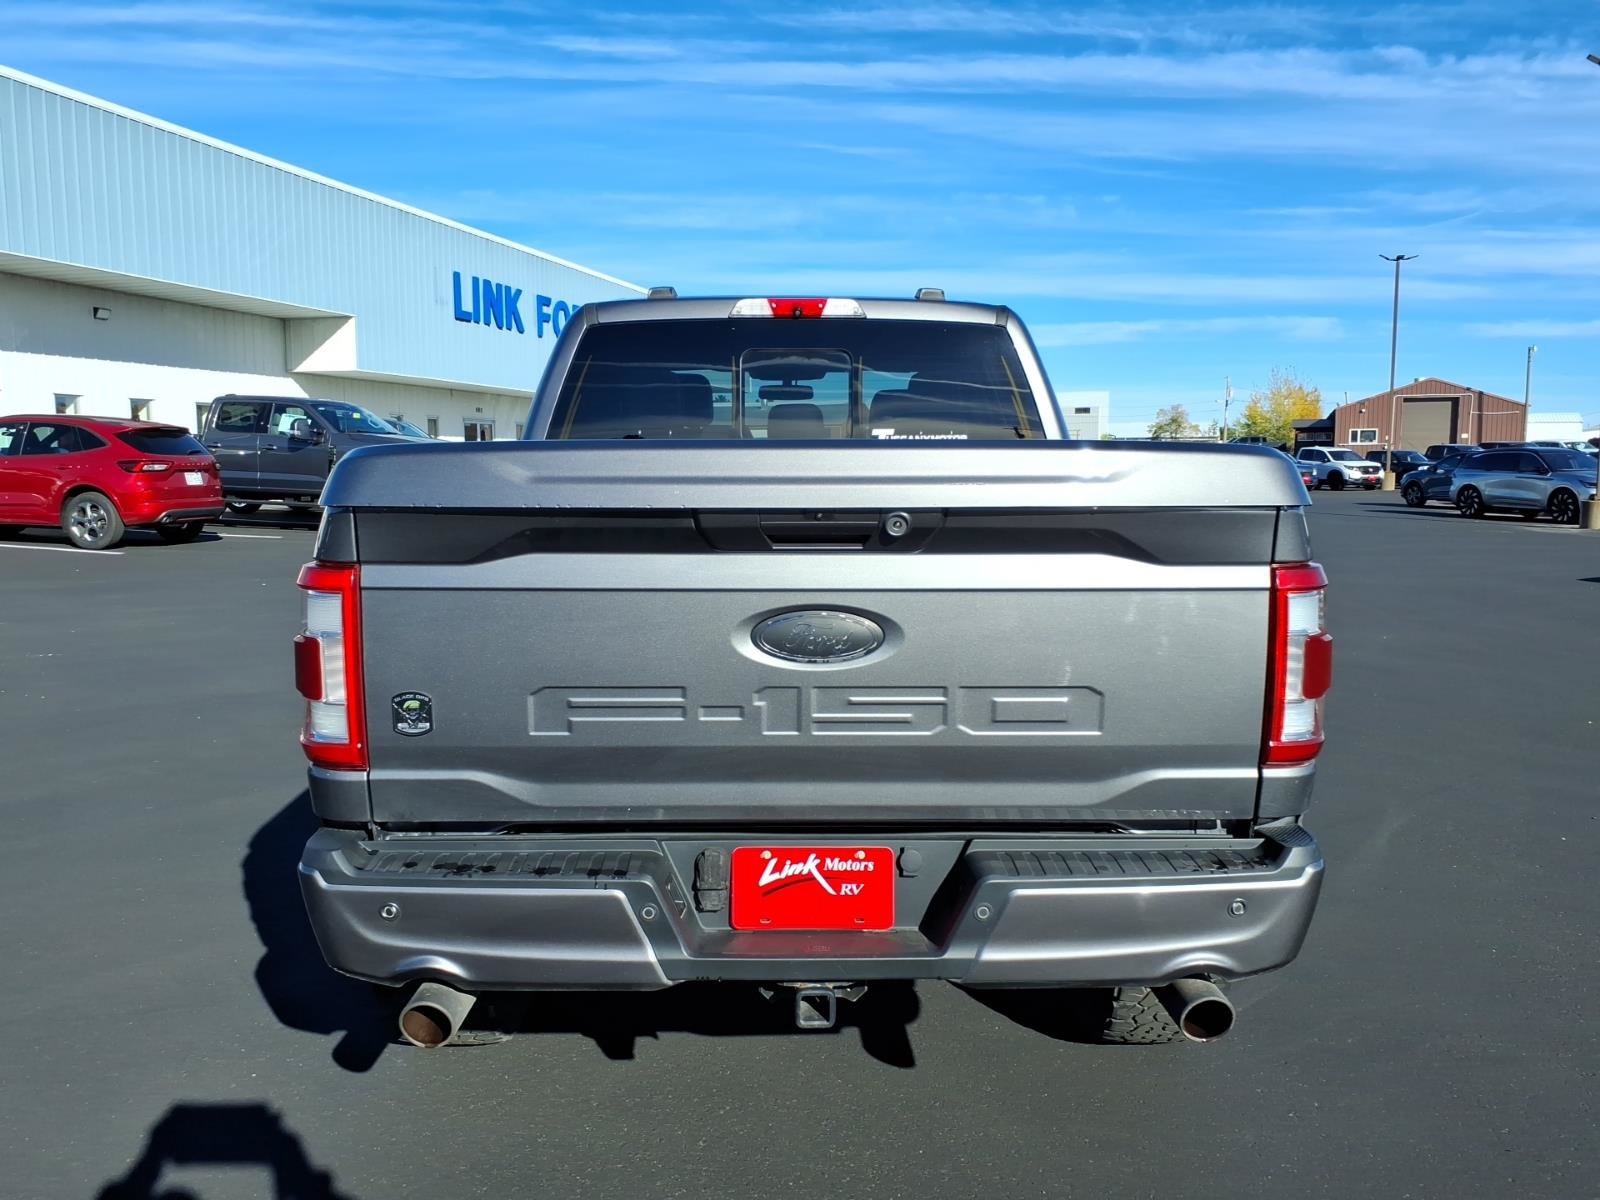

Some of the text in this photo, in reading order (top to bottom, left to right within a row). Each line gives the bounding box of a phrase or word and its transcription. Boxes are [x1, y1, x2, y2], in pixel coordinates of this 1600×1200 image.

[453, 271, 580, 338] LINK FO
[785, 622, 851, 650] Ford
[527, 686, 1105, 737] F-150
[758, 853, 875, 895] Link Motors
[839, 883, 865, 896] RV
